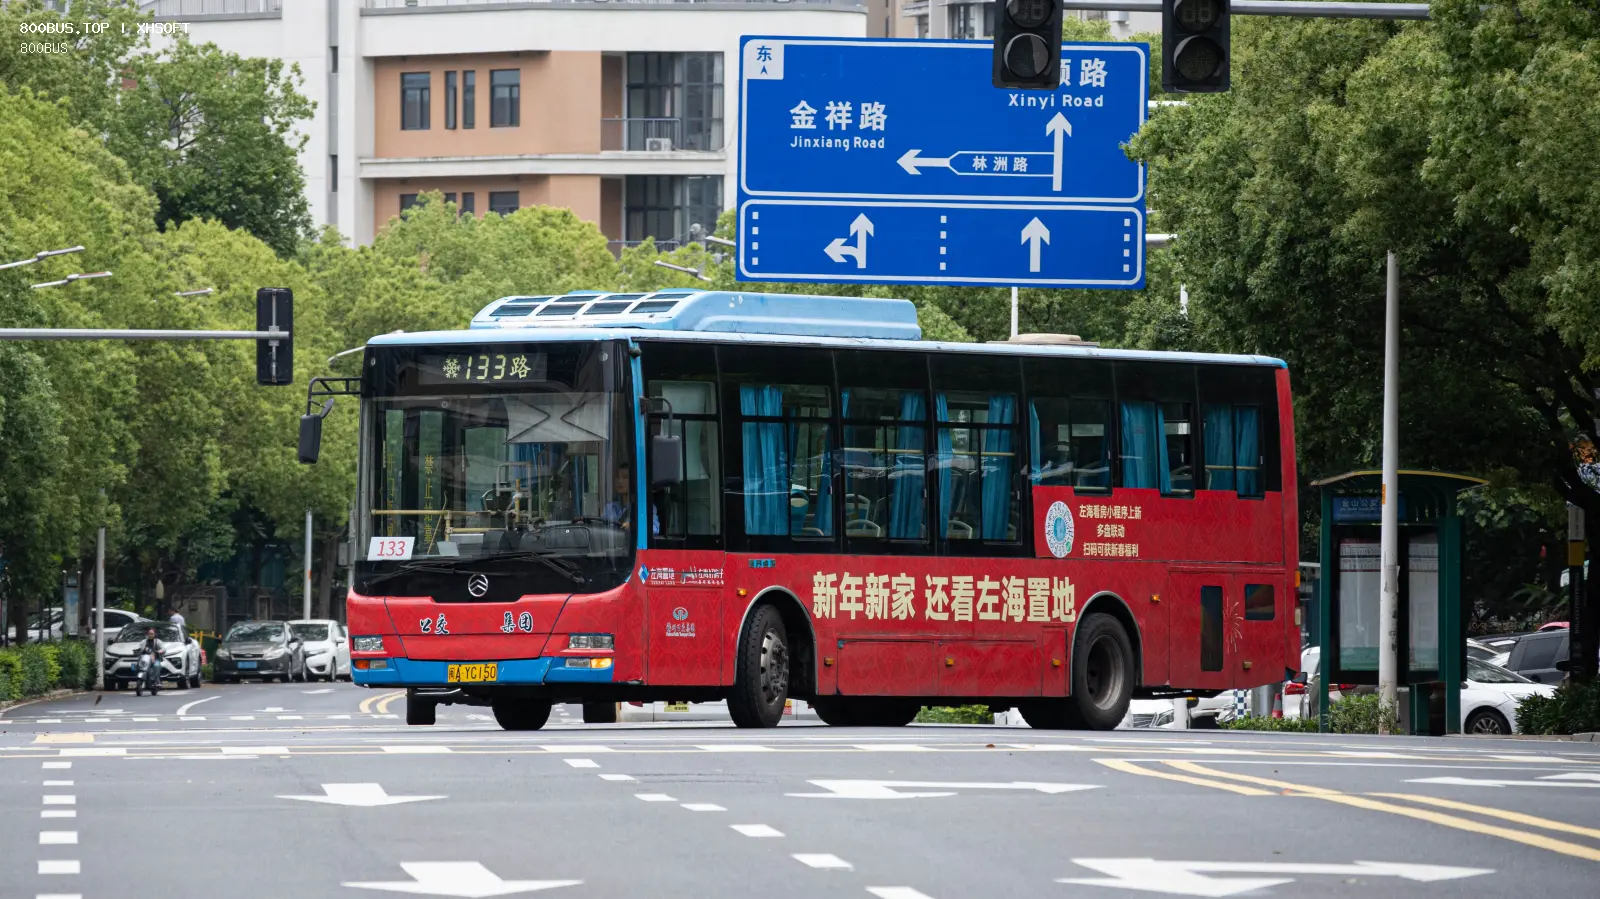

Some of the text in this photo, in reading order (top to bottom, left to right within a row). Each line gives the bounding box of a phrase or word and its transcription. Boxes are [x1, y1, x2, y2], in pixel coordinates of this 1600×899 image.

[756, 45, 772, 62] 东
[1008, 93, 1104, 110] Xinyi Road
[789, 99, 888, 131] 金祥路
[790, 136, 885, 152] Jinxiang Road
[972, 155, 1028, 172] 林洲路
[465, 354, 532, 380] 133路
[1079, 504, 1142, 520] 左海看房小程序上新
[1097, 523, 1125, 538] 多盘联动
[377, 541, 406, 556] 133
[1083, 542, 1139, 557] 扫码可获新春福利
[812, 571, 1077, 623] 新年新家 还看左海置地
[419, 611, 534, 634] 公交 集团
